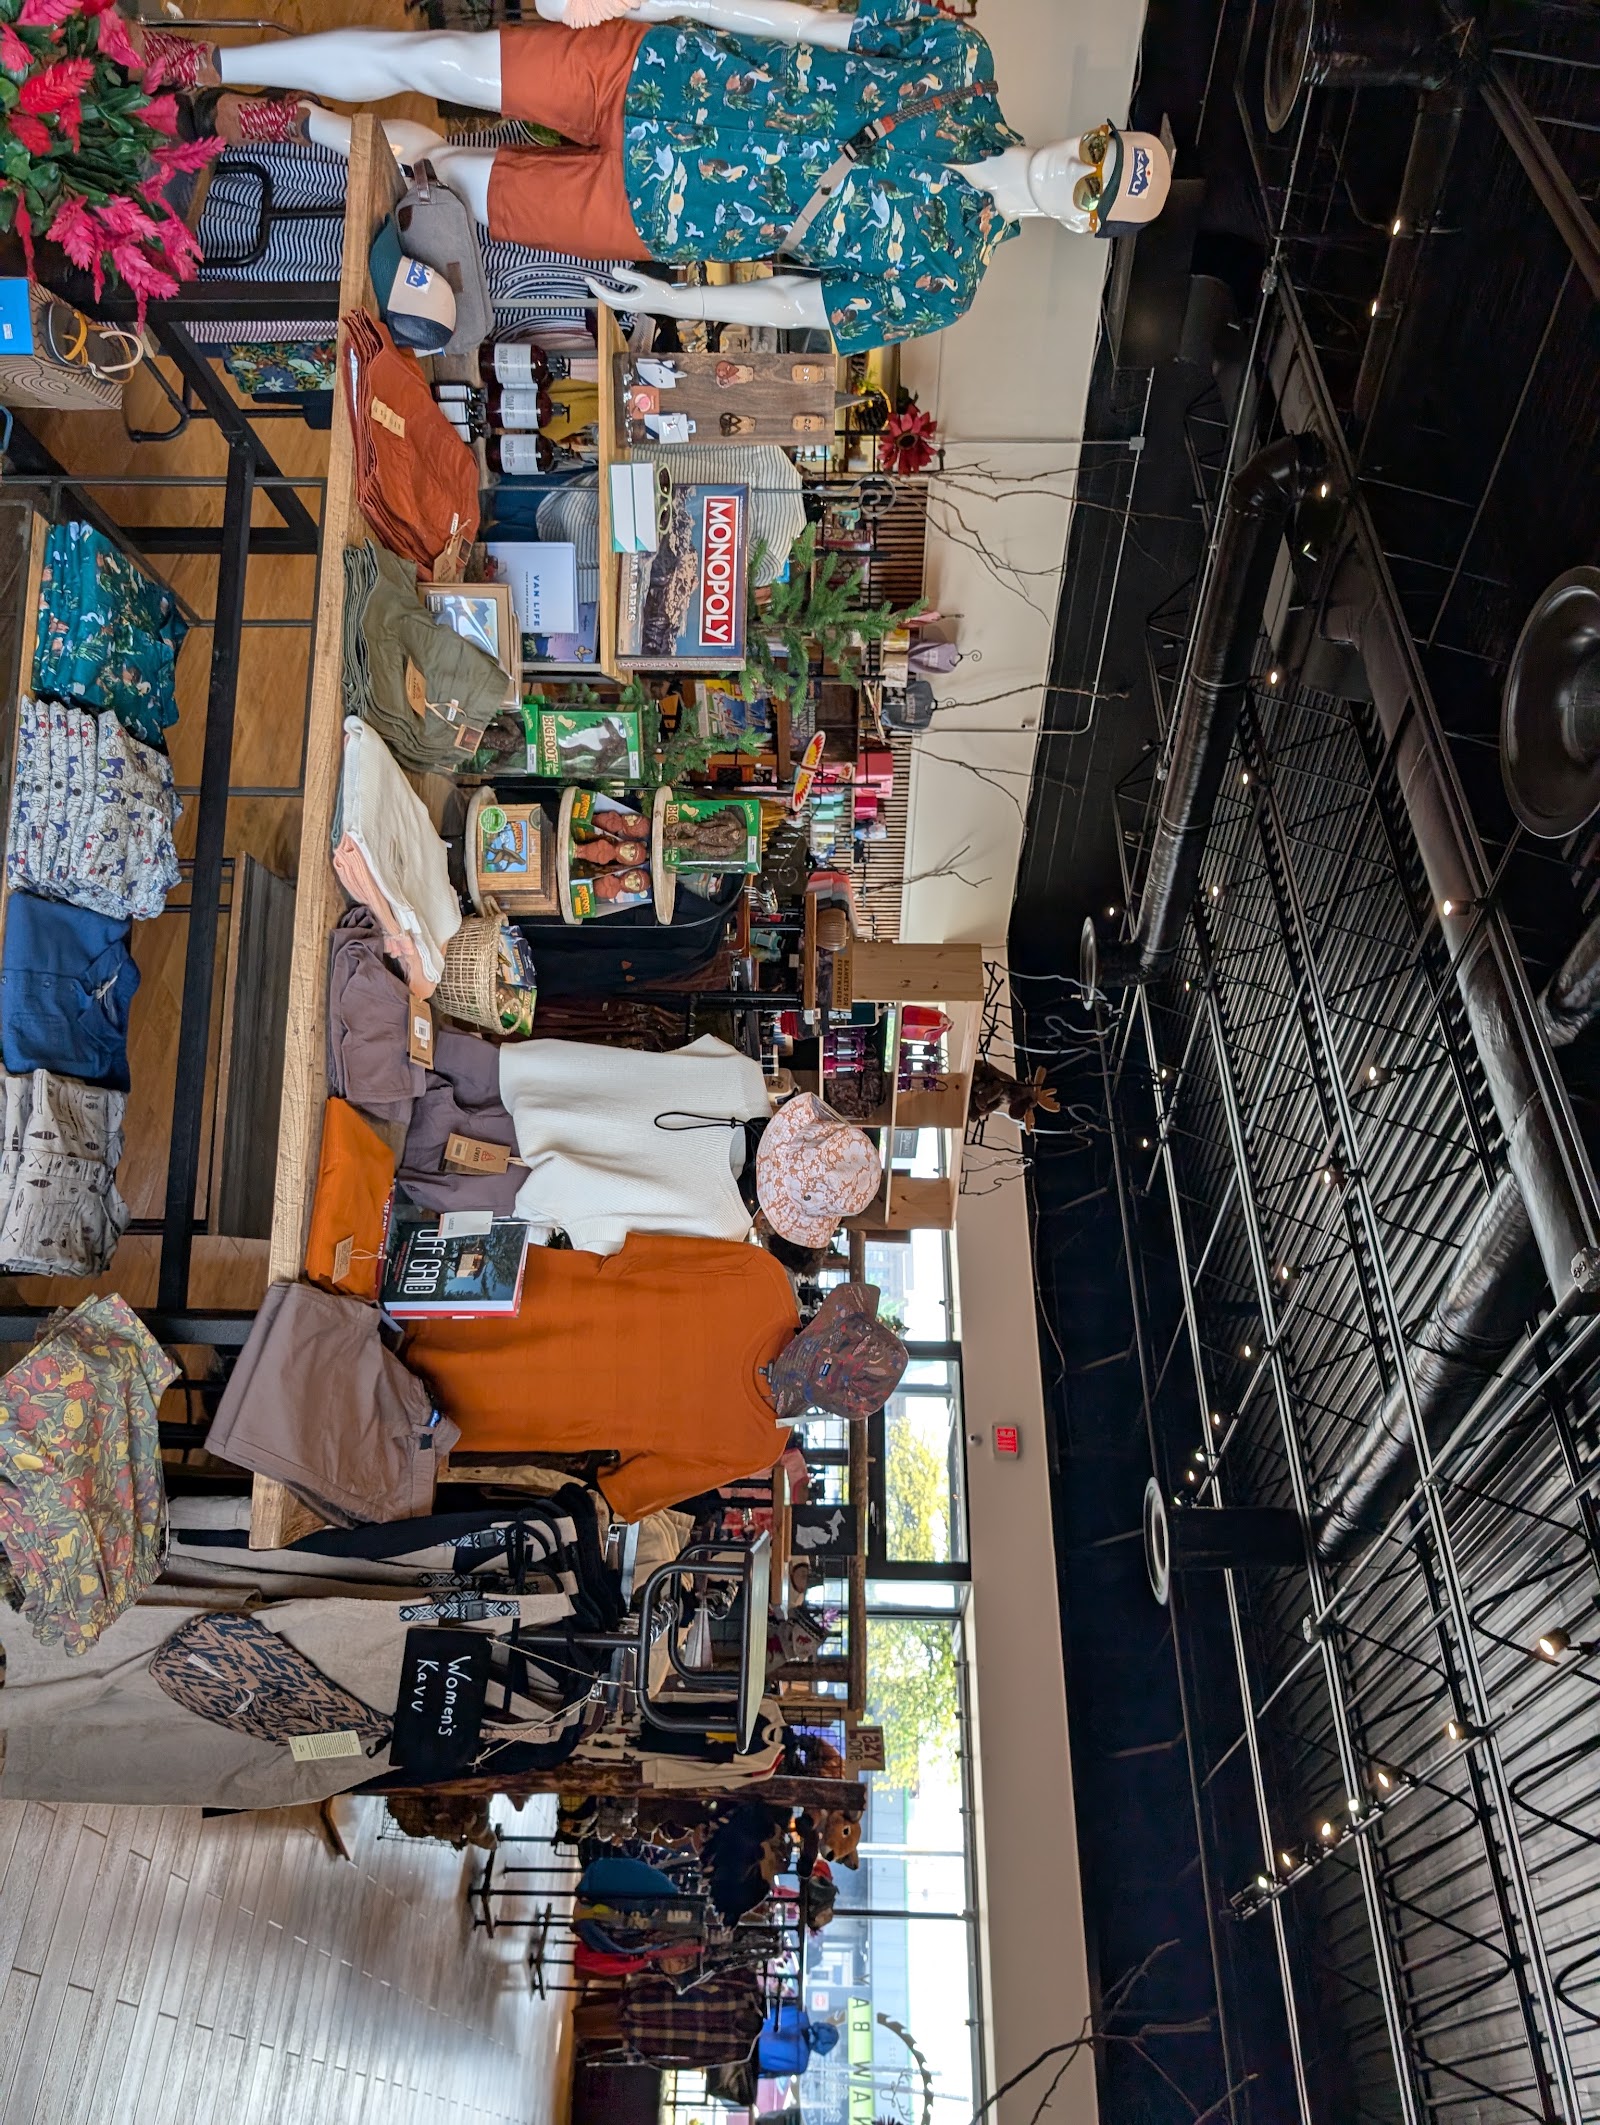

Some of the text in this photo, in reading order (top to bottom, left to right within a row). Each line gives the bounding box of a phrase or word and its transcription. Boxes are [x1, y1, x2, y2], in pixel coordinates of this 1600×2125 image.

[1131, 150, 1145, 193] KAVU
[498, 350, 508, 365] SOAP
[504, 396, 514, 411] SOAP
[504, 442, 514, 457] SOAP
[704, 501, 732, 642] MONOPOLY
[627, 582, 637, 621] PARKS
[543, 716, 557, 762] BIGFOOT
[414, 1229, 447, 1256] OFF
[403, 1259, 442, 1294] GRID
[998, 1428, 1017, 1452] EXIT
[438, 1655, 472, 1737] Women's
